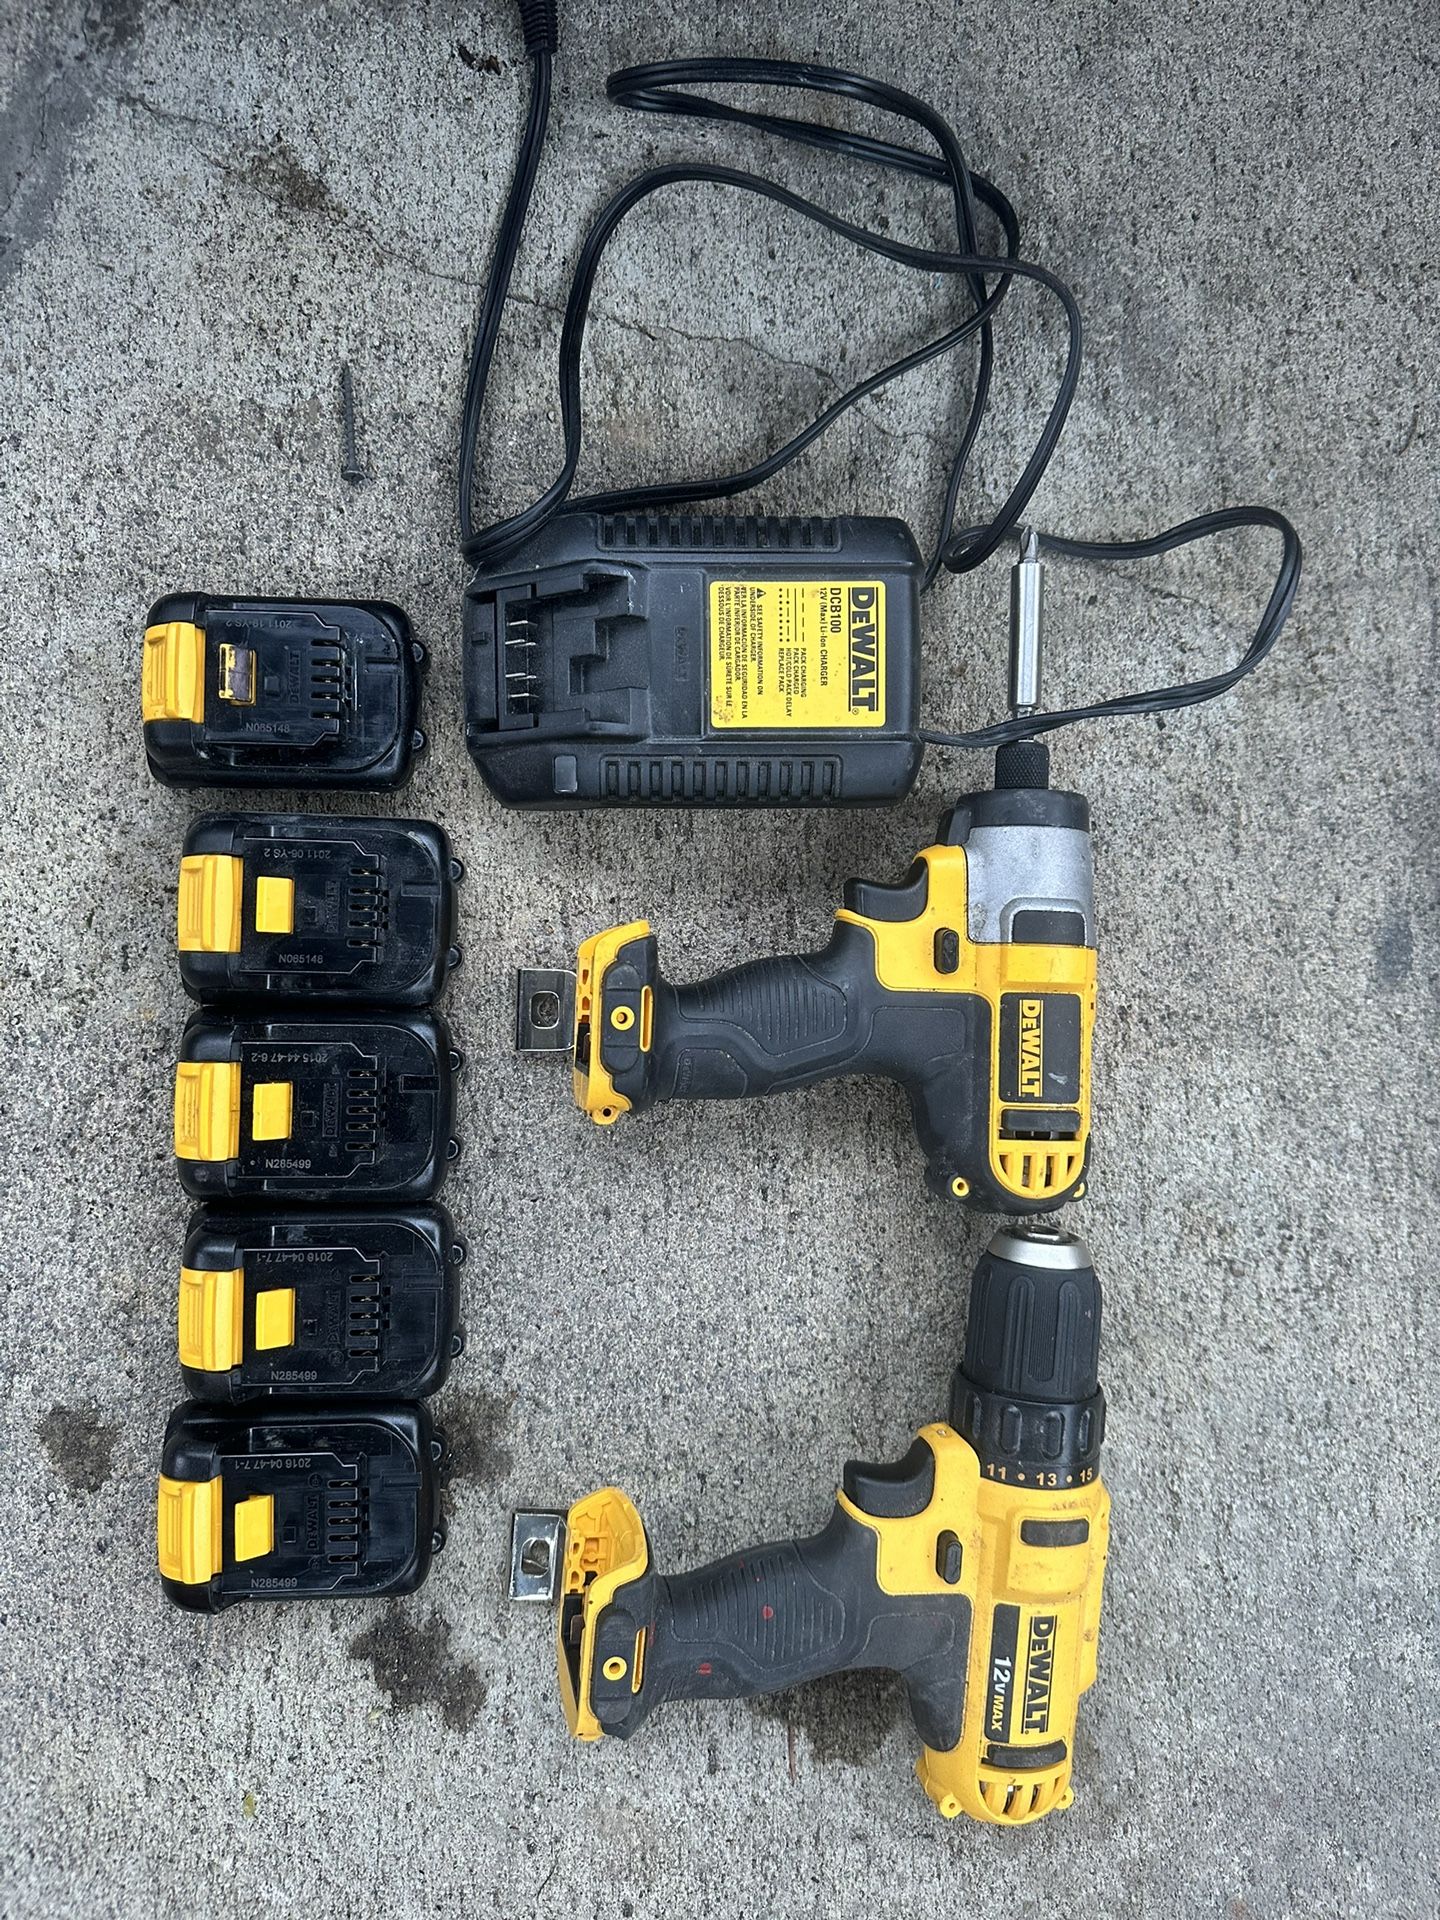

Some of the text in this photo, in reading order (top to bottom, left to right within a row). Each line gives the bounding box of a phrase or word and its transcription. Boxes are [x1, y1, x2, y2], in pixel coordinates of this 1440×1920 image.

[741, 600, 747, 608] LA
[819, 602, 827, 624] (Max)
[830, 588, 841, 633] DCB100
[719, 617, 724, 625] DE
[750, 623, 756, 631] OF
[734, 637, 740, 645] DE
[852, 587, 875, 712] DEWALT
[742, 654, 747, 662] DE
[757, 686, 763, 695] ON
[742, 701, 747, 709] EN
[263, 847, 271, 858] 2
[307, 849, 332, 860] 2011
[1022, 999, 1041, 1097] DEWALT
[303, 1052, 329, 1064] 2015
[265, 1158, 312, 1169] N285499
[256, 1252, 272, 1263] 7-1
[275, 1251, 305, 1263] 04-47
[270, 1370, 318, 1381] N285499
[235, 1459, 251, 1470] 7-1
[253, 1458, 283, 1470] 04-47
[986, 1463, 1093, 1487] 11 13 15
[250, 1576, 298, 1588] N285499
[1023, 1616, 1055, 1733] DEWALT
